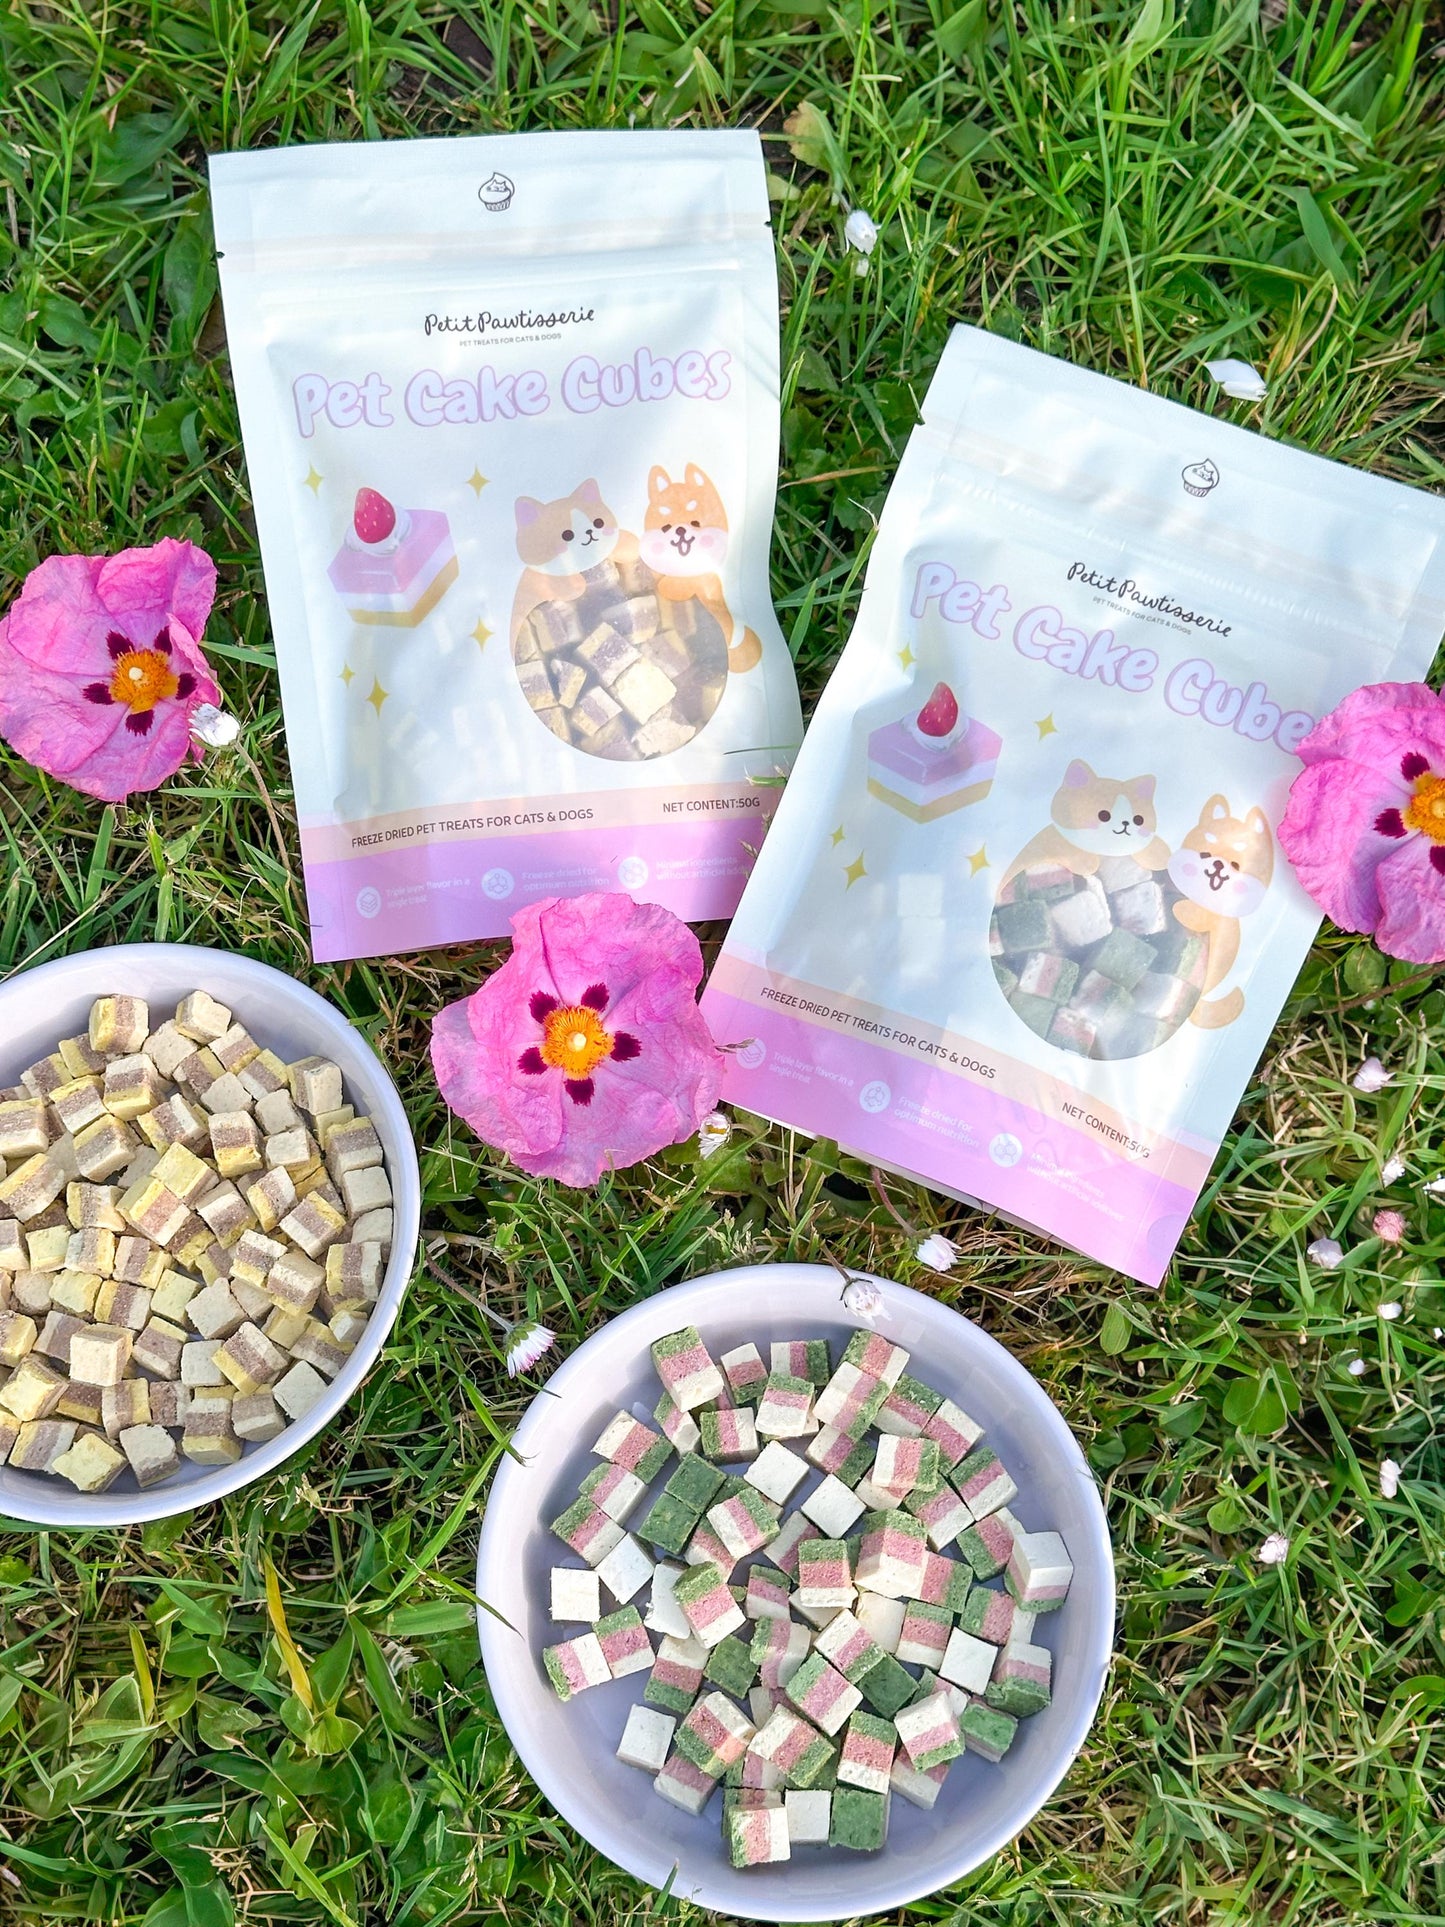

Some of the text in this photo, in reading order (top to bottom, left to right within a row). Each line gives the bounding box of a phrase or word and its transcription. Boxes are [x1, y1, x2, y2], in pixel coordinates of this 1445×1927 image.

[425, 307, 595, 336] Petit Pawtisserie
[459, 339, 472, 347] PET
[473, 338, 499, 346] TREATS
[515, 335, 534, 343] CATS
[541, 333, 562, 341] DOGS
[293, 347, 732, 438] Pet Cake Cubes
[1067, 562, 1232, 637] Petit Pawtisserie
[1093, 596, 1107, 605] PET
[1106, 599, 1131, 616] TREATS
[1131, 610, 1146, 621] FOR
[1146, 615, 1165, 626] CATS
[1171, 622, 1193, 636] DOGS
[910, 562, 1315, 756] Pet Cake Cube
[663, 797, 760, 812] NET CONTENT:50G
[351, 808, 594, 848] FREEZE DRIED PET TREATS FOR CATS & DOGS
[760, 987, 997, 1080] FREEZE DRIED PET TREATS FOR CATS & DOGS
[1061, 1101, 1086, 1120] NET
